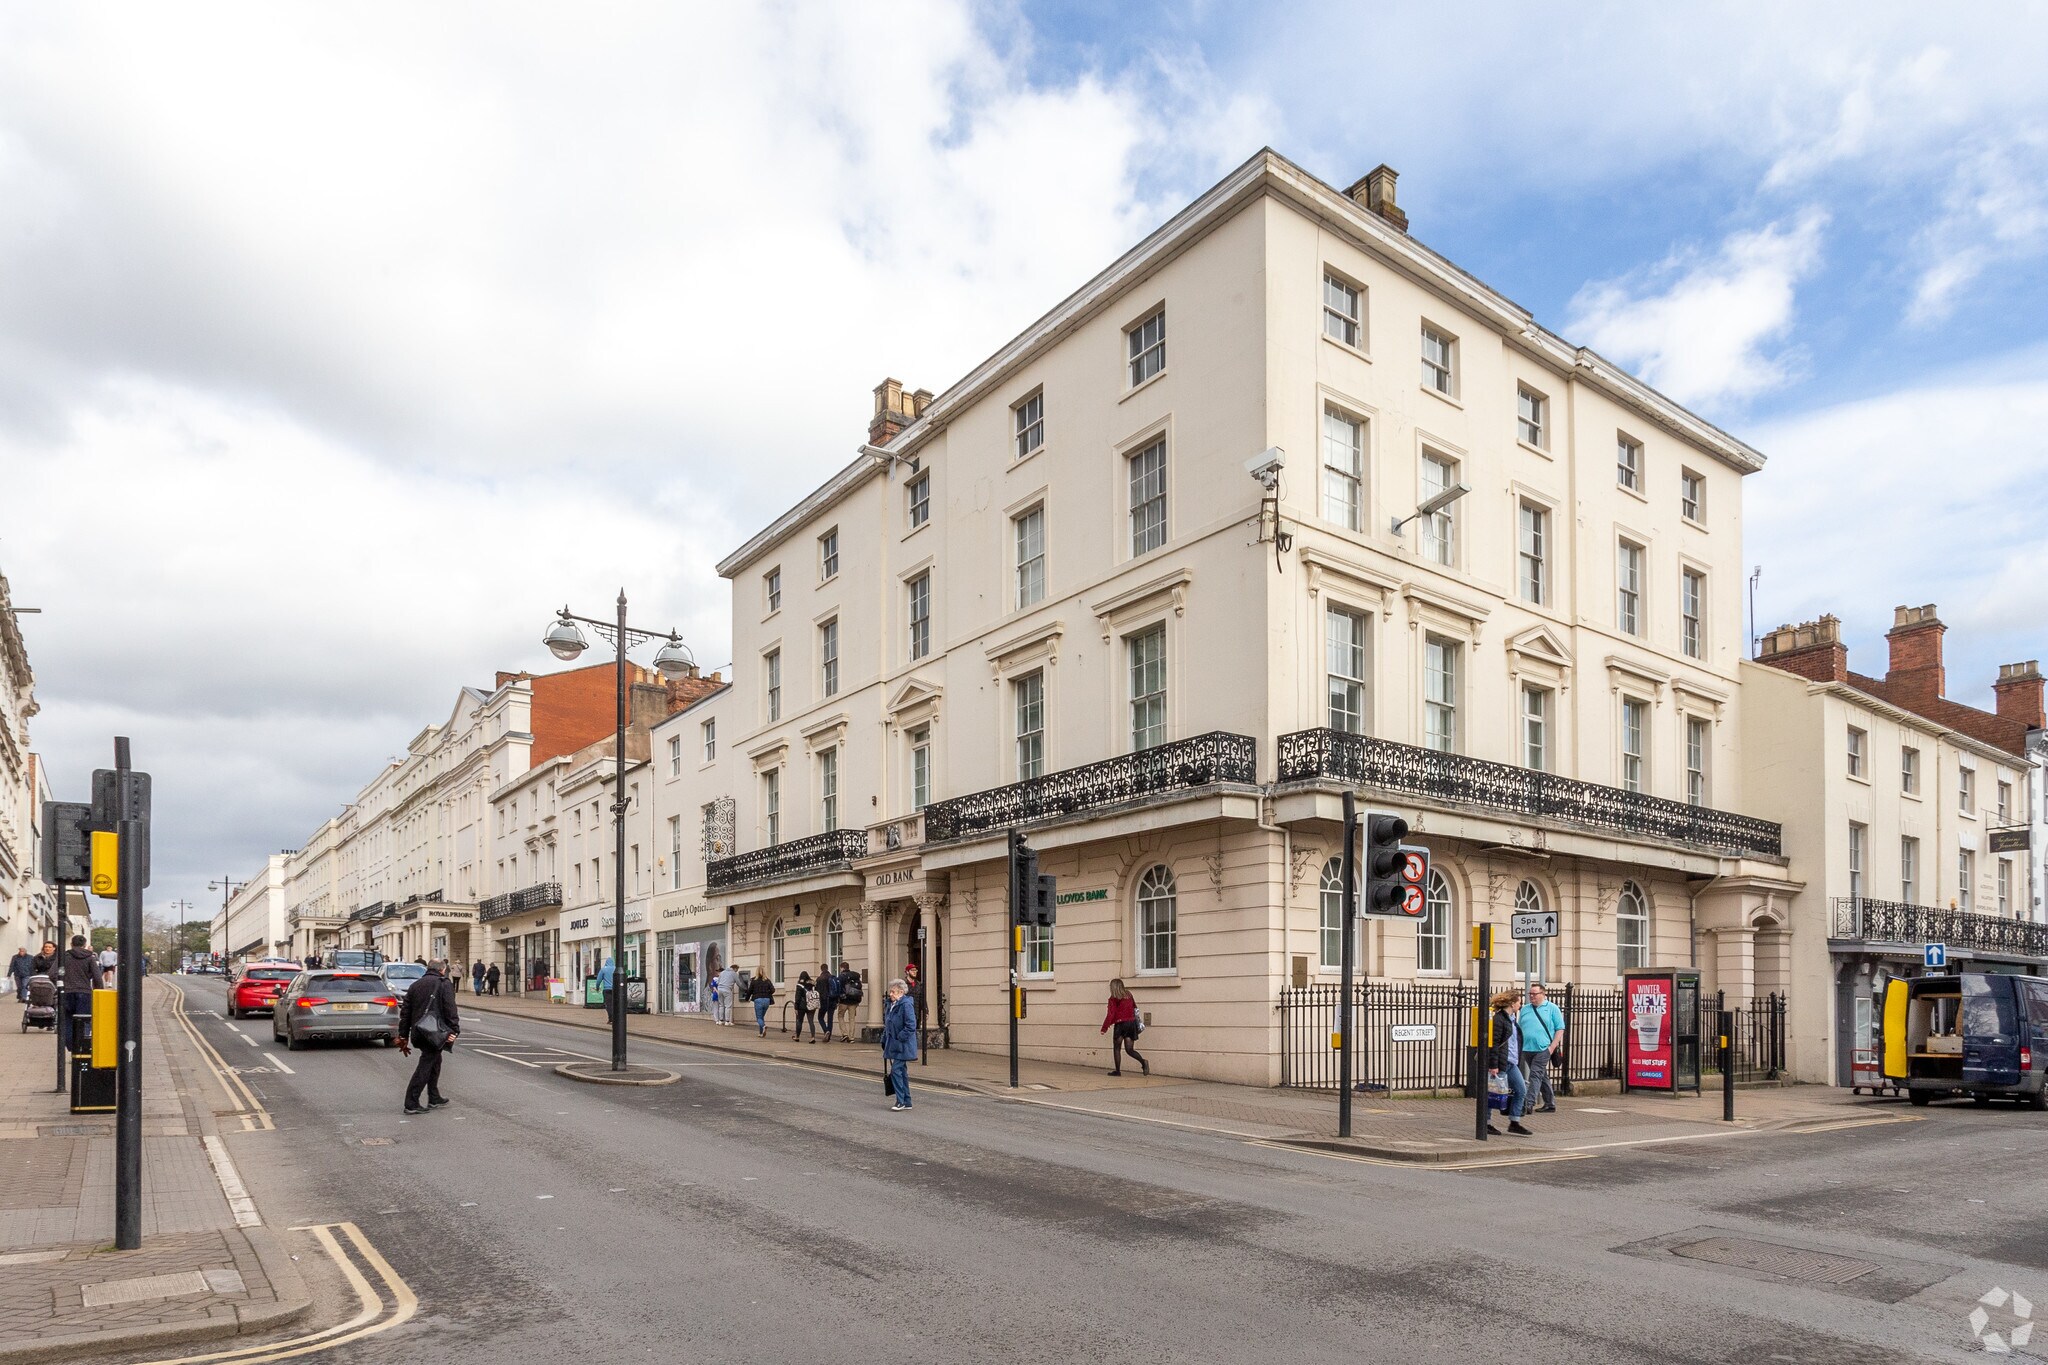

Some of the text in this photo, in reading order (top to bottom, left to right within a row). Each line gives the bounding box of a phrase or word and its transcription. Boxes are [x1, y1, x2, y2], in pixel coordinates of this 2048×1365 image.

[876, 869, 914, 886] OLD BANK
[1056, 889, 1108, 905] LLOYDS BANK
[662, 905, 689, 919] Charnley's
[570, 918, 589, 930] JOULES
[1520, 917, 1537, 925] Spa
[1632, 994, 1667, 1005] WE'VE
[1632, 1005, 1667, 1014] GOT THIS
[1416, 1028, 1434, 1036] STREET
